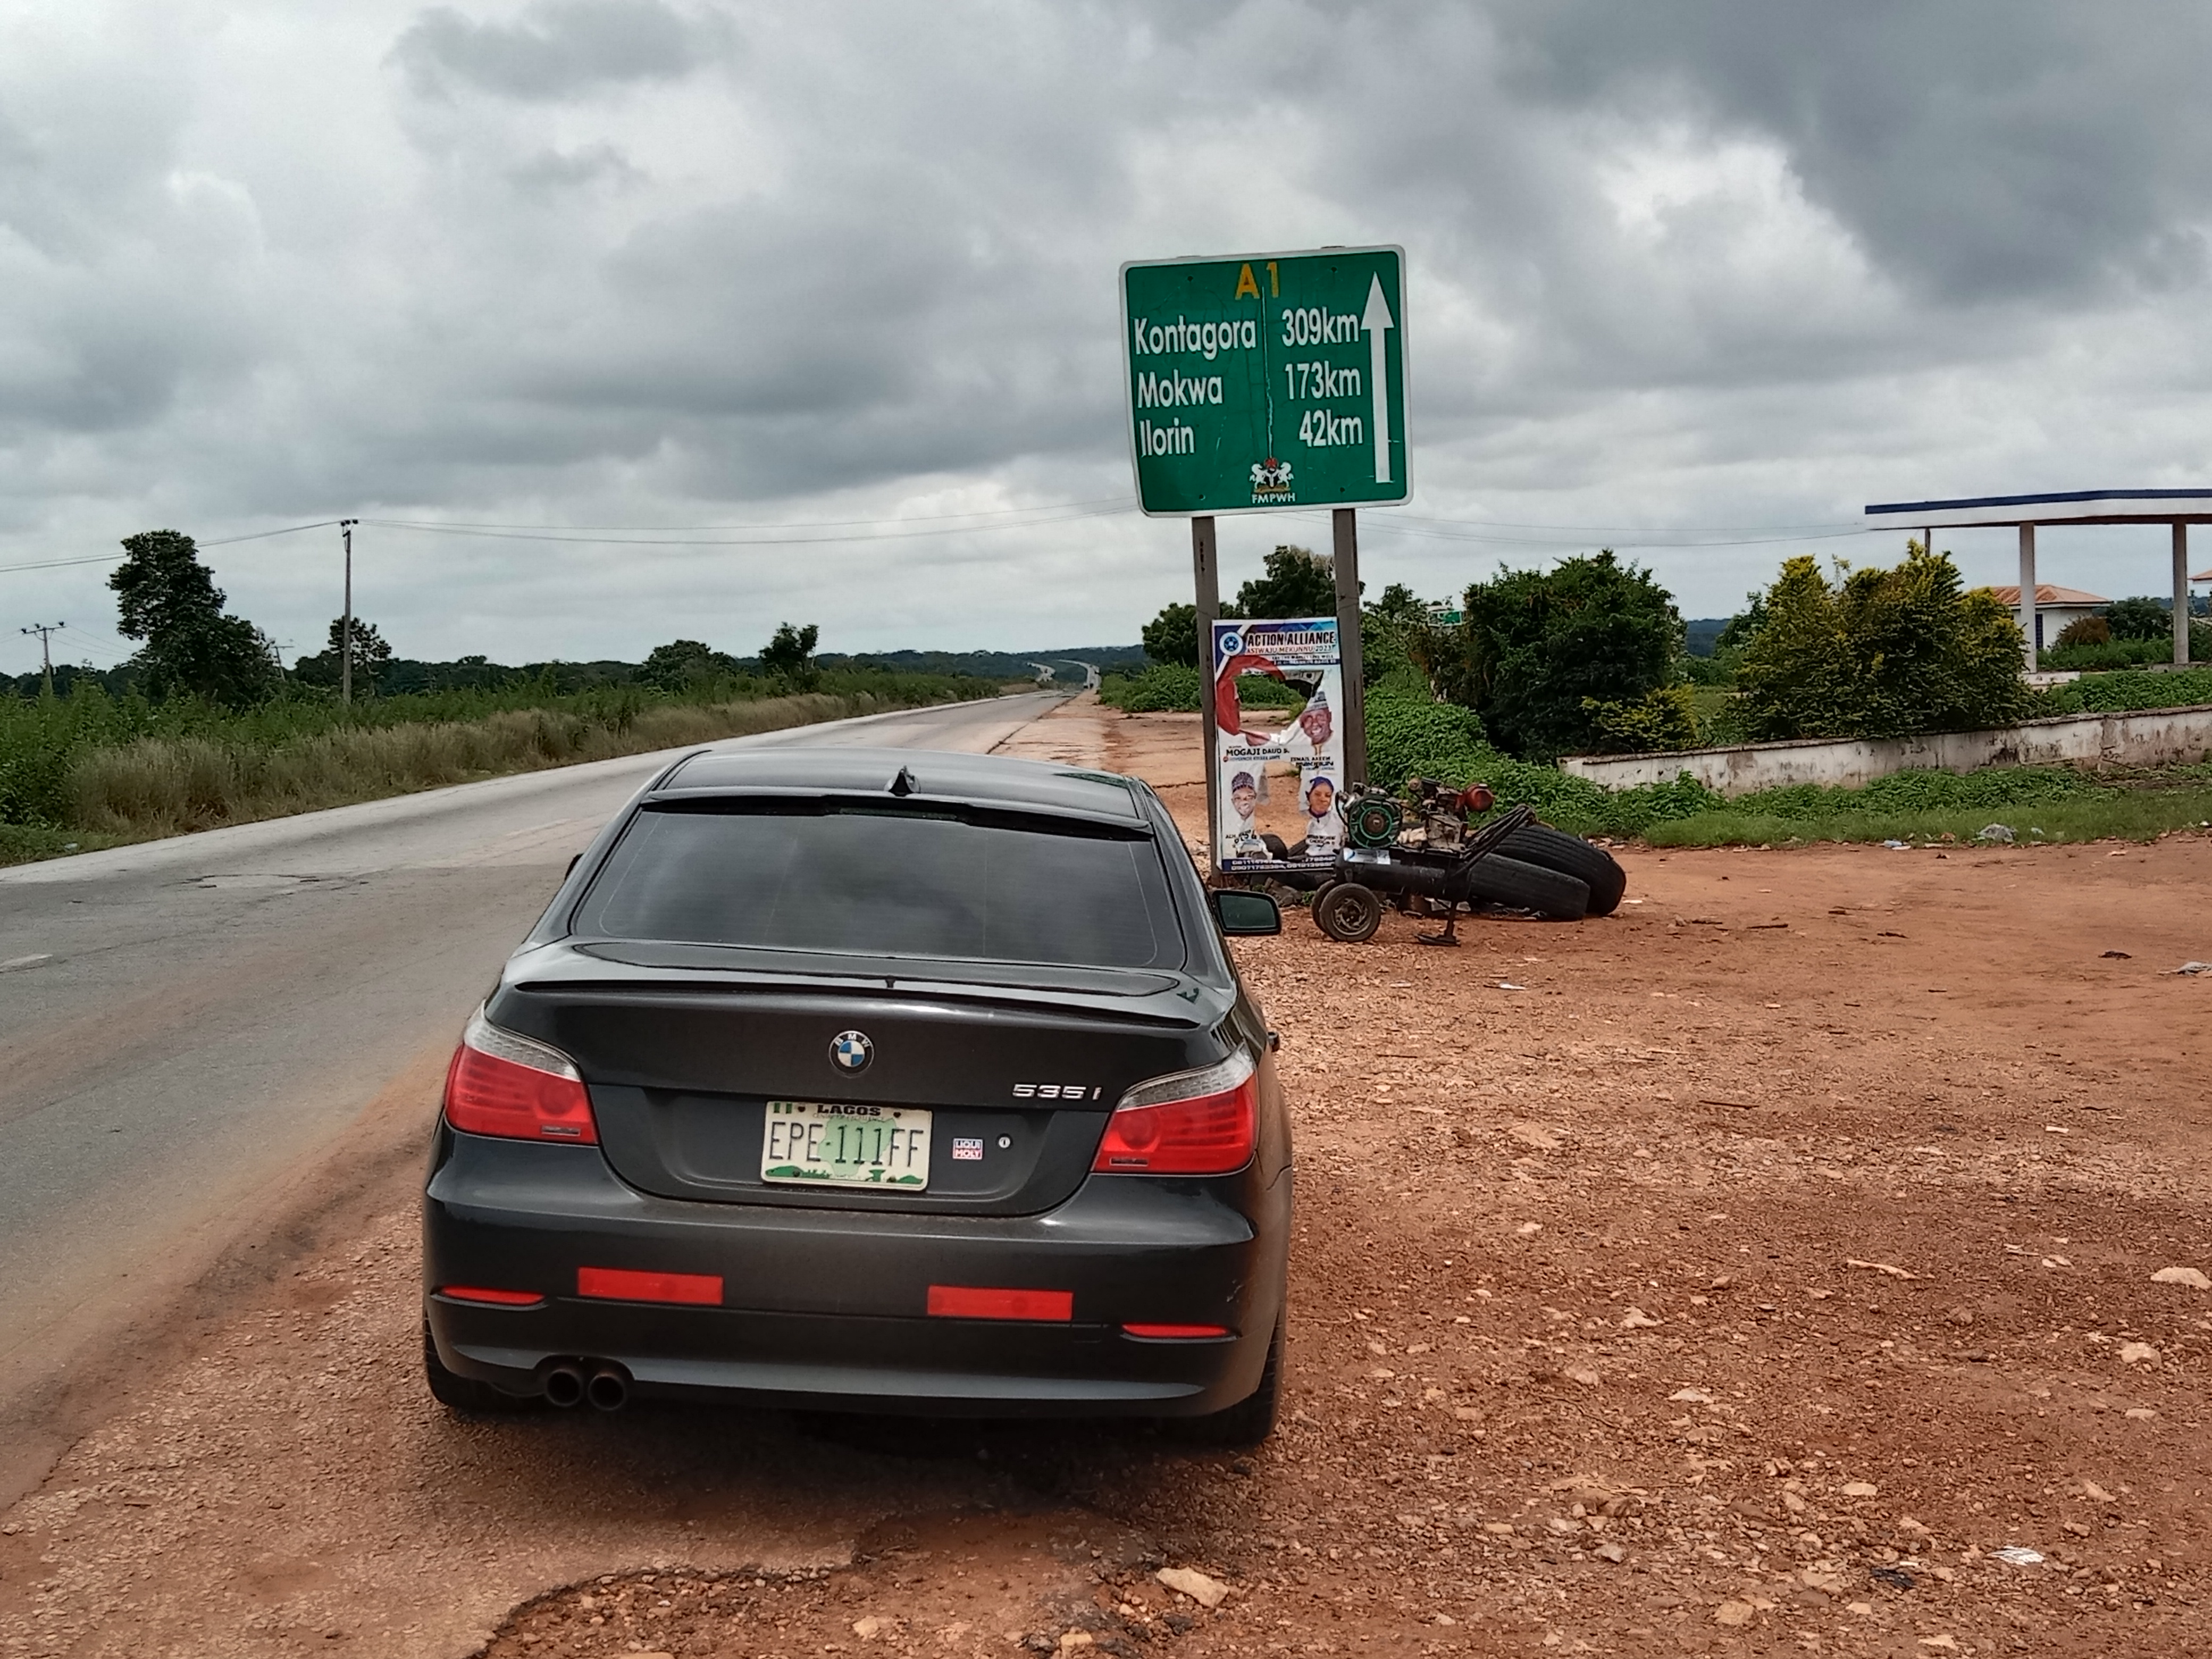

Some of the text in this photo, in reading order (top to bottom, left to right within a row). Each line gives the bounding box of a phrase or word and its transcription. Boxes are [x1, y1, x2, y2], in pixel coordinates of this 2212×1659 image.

[1134, 306, 1360, 361] Kontagora 309km
[1138, 361, 1361, 408] Mokwa 173km
[1140, 409, 1363, 457] Ilorin 42km
[1252, 492, 1296, 504] FMPWH
[1247, 632, 1335, 647] ACTION ALLIANCE
[835, 1033, 871, 1048] BMW
[817, 1104, 881, 1116] LAGOS
[955, 1140, 981, 1149] LIQUI
[955, 1149, 981, 1158] MOLY
